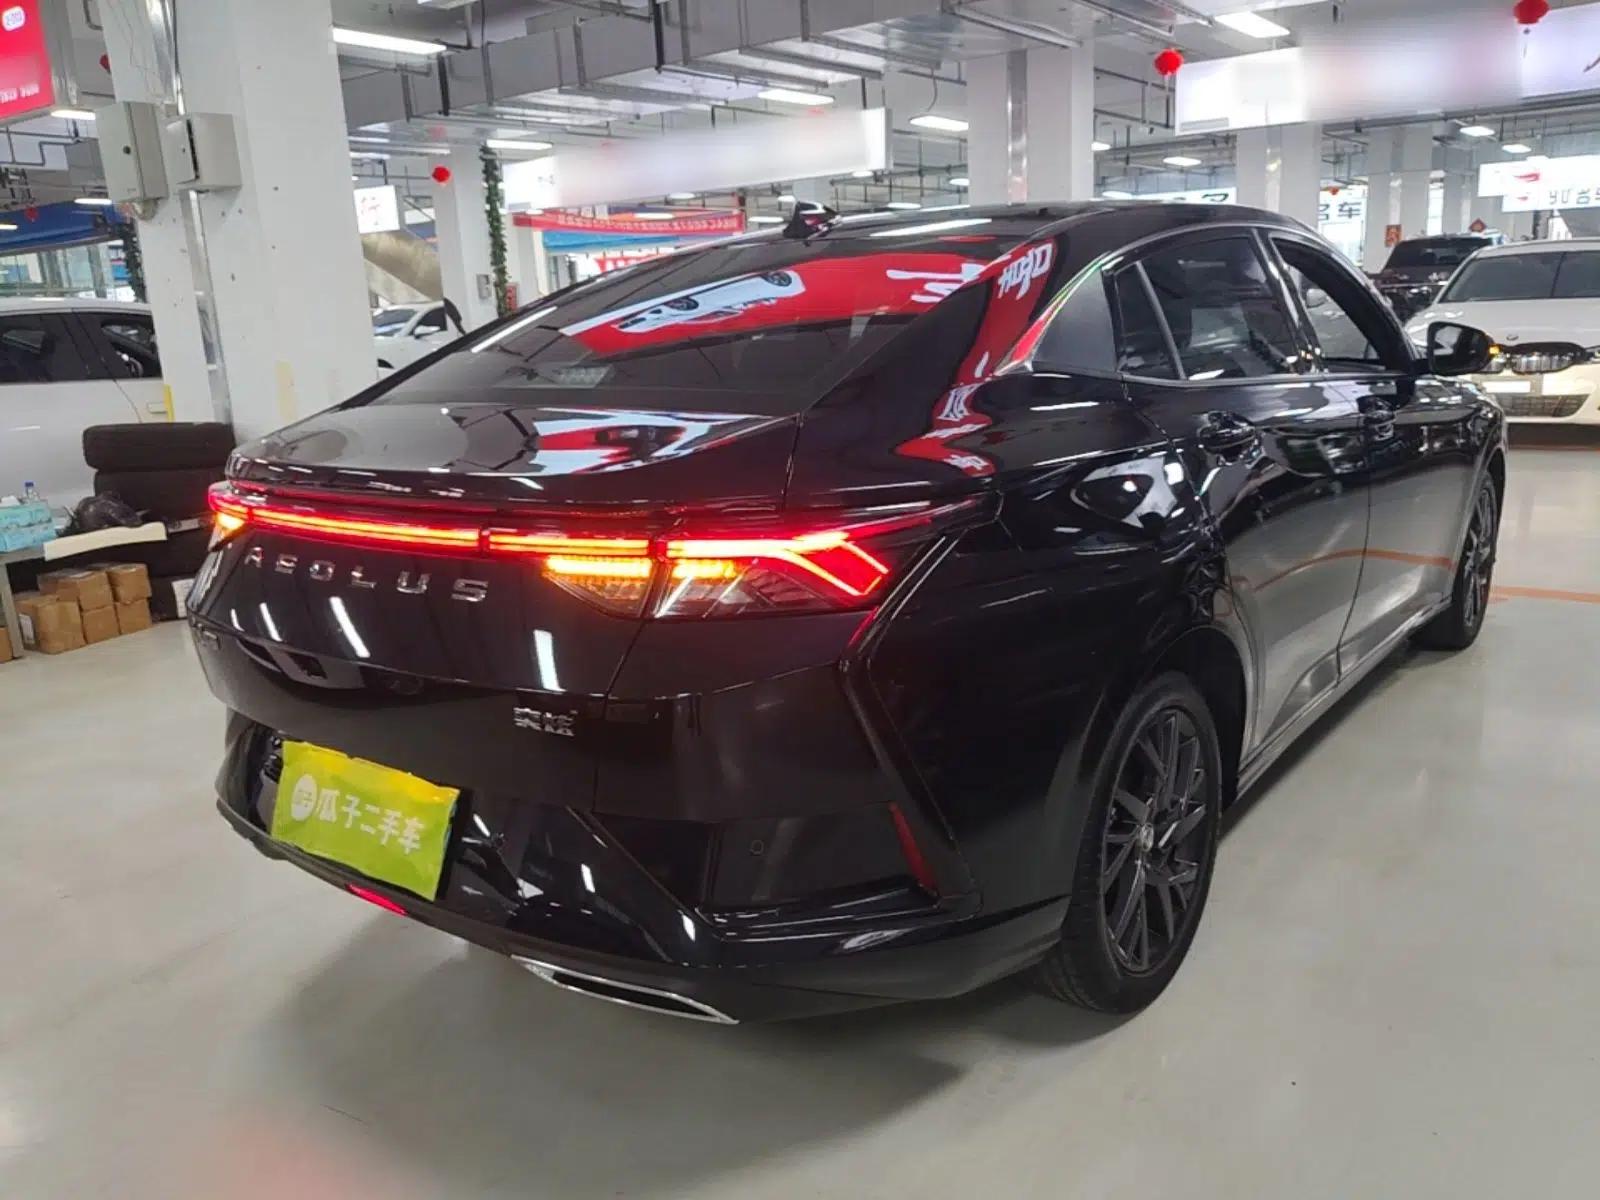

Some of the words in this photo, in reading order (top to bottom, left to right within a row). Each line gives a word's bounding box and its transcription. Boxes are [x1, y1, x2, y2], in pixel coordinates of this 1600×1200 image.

[245, 547, 489, 602] AEOLUS
[317, 788, 425, 855] 瓜子二手车
